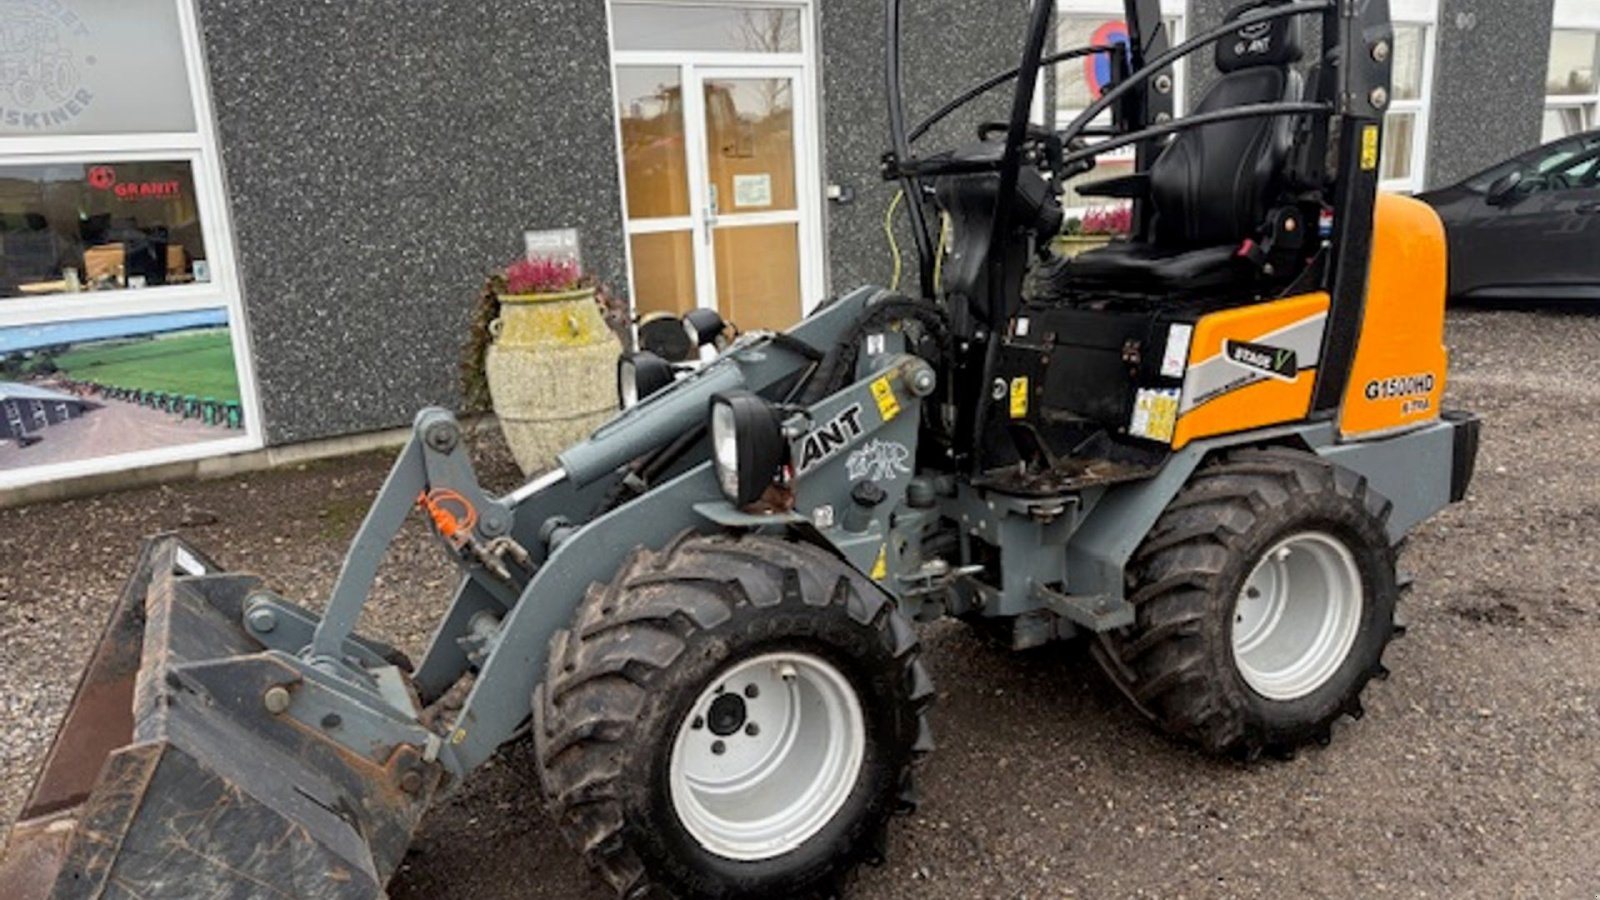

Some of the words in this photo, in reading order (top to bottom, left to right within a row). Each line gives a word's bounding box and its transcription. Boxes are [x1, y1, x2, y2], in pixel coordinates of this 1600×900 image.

[114, 182, 179, 197] GRANIT
[1234, 347, 1272, 369] STAGE
[1365, 374, 1433, 399] G1500HD
